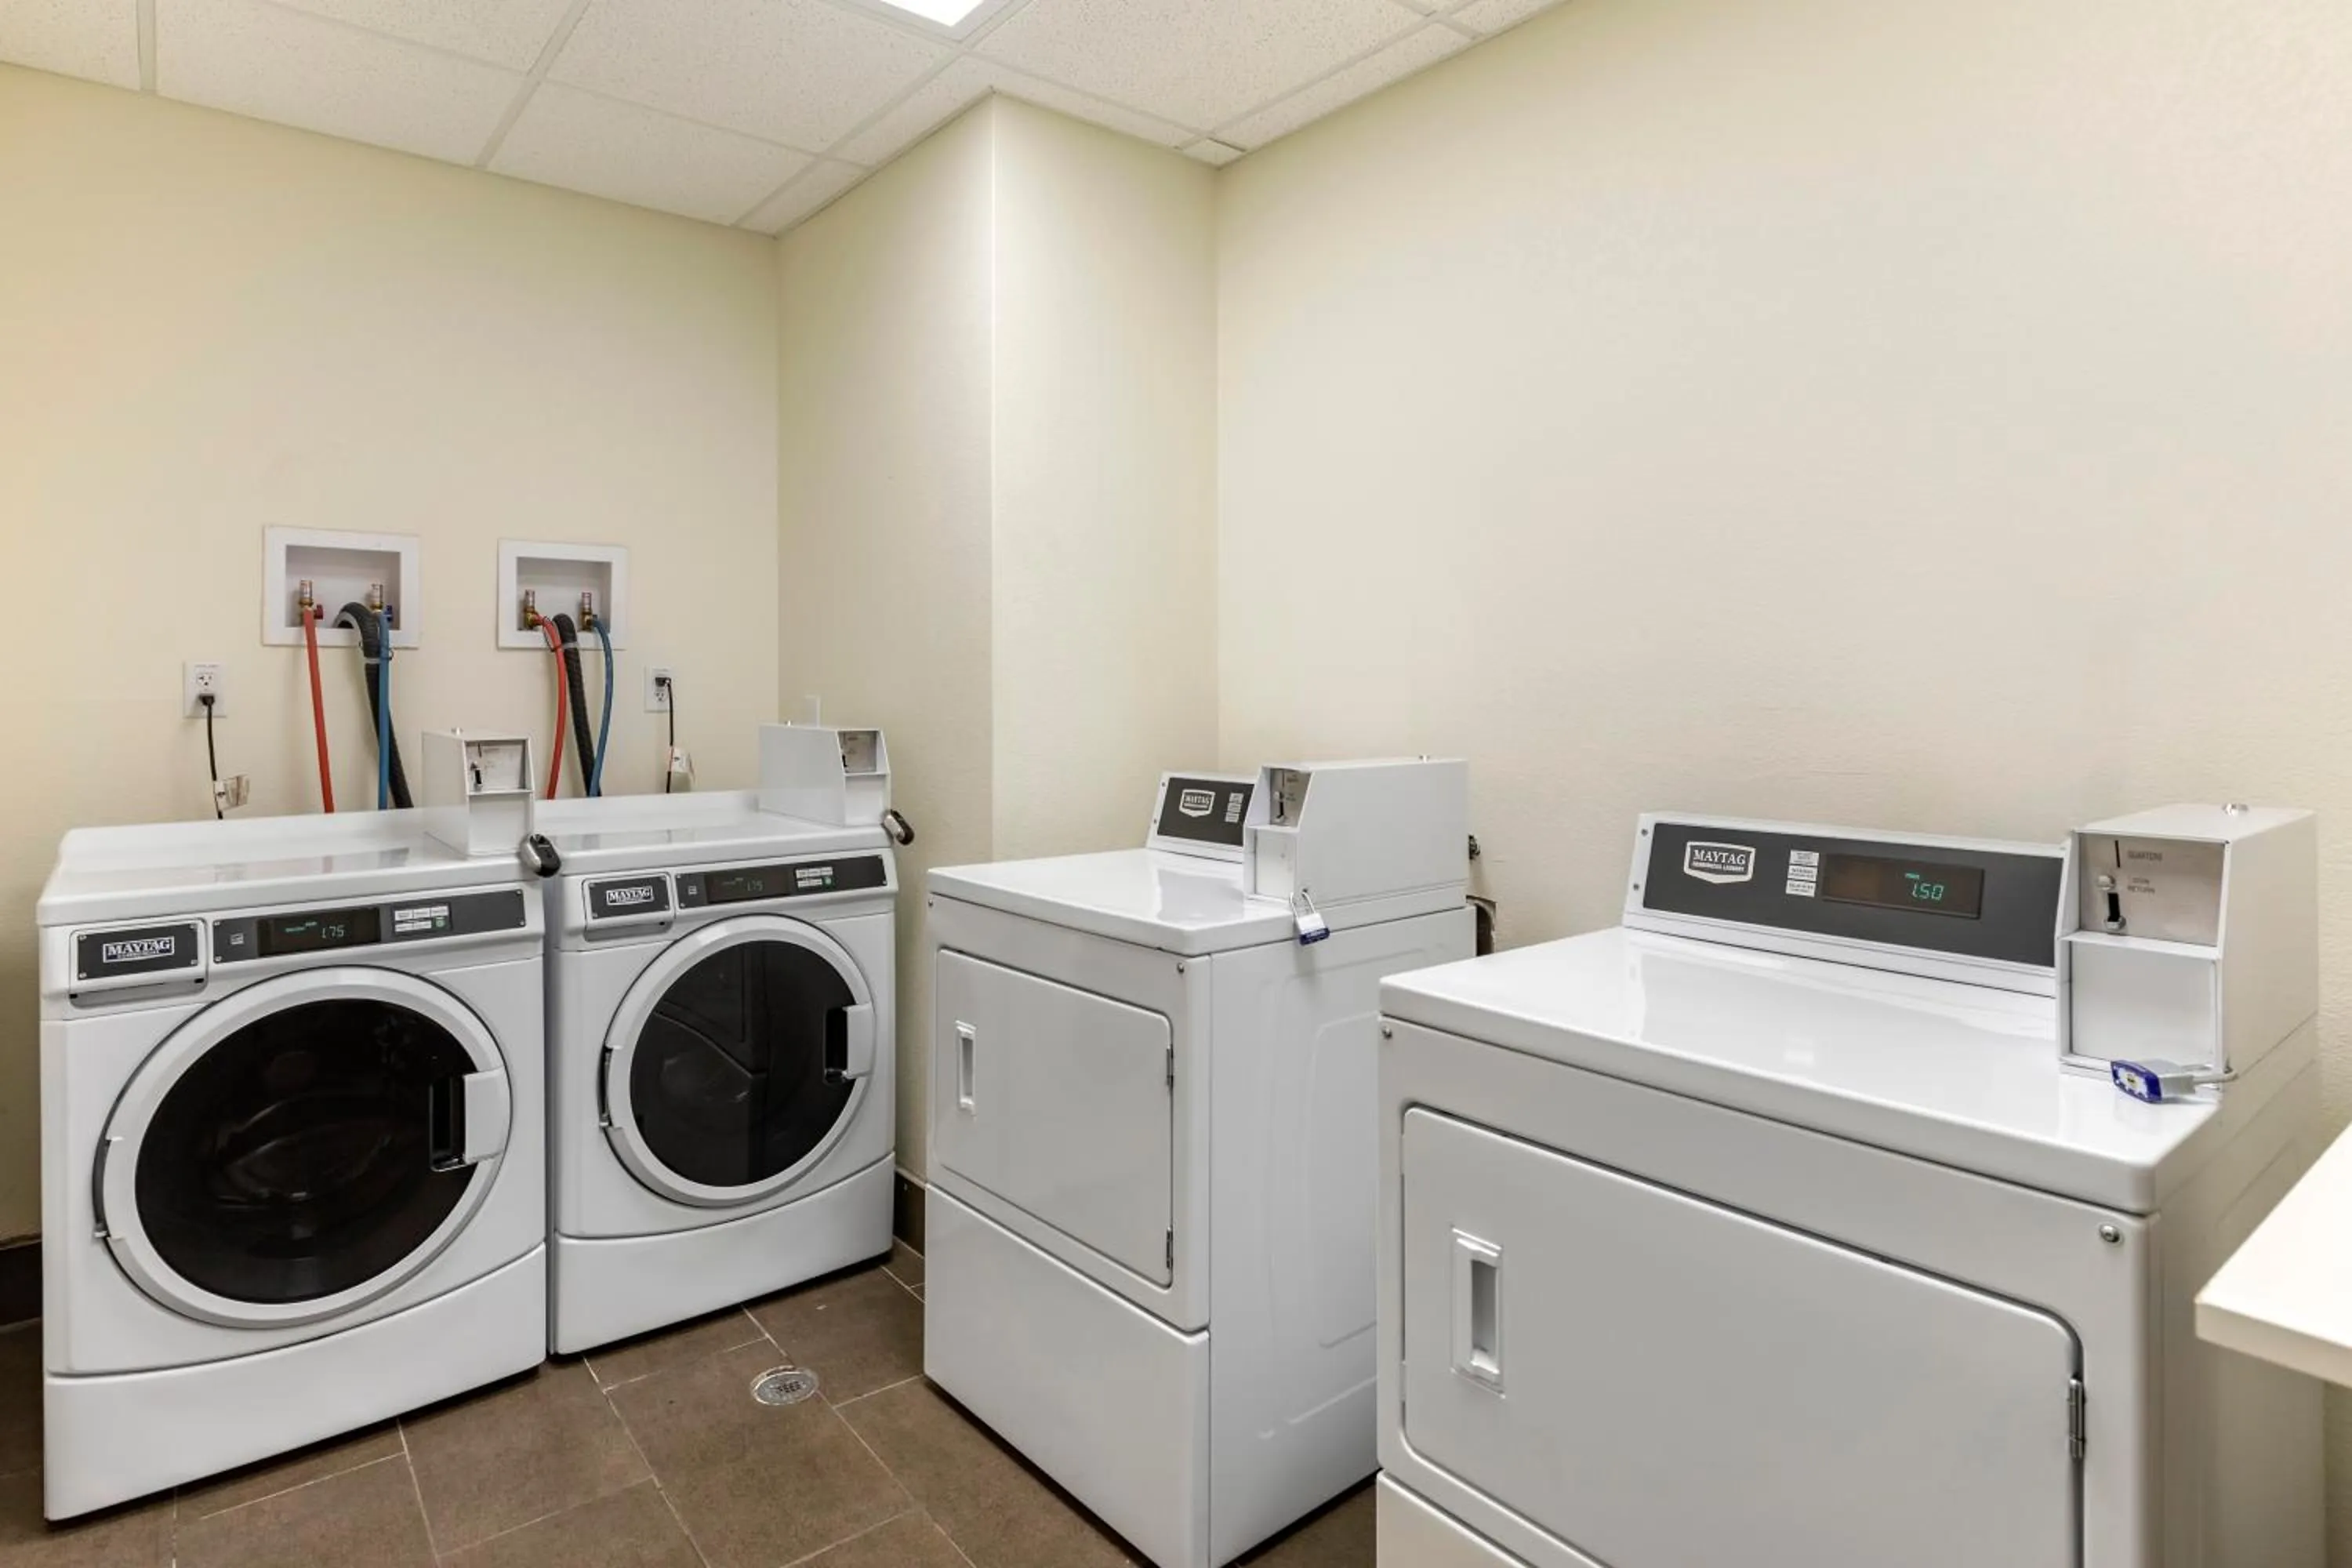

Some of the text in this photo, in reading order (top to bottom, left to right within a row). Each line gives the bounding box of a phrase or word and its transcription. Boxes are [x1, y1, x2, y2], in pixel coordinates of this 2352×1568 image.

[1693, 849, 1746, 865] MAYTAG
[609, 887, 650, 902] MAYTAG
[107, 940, 170, 956] MAYTAG
